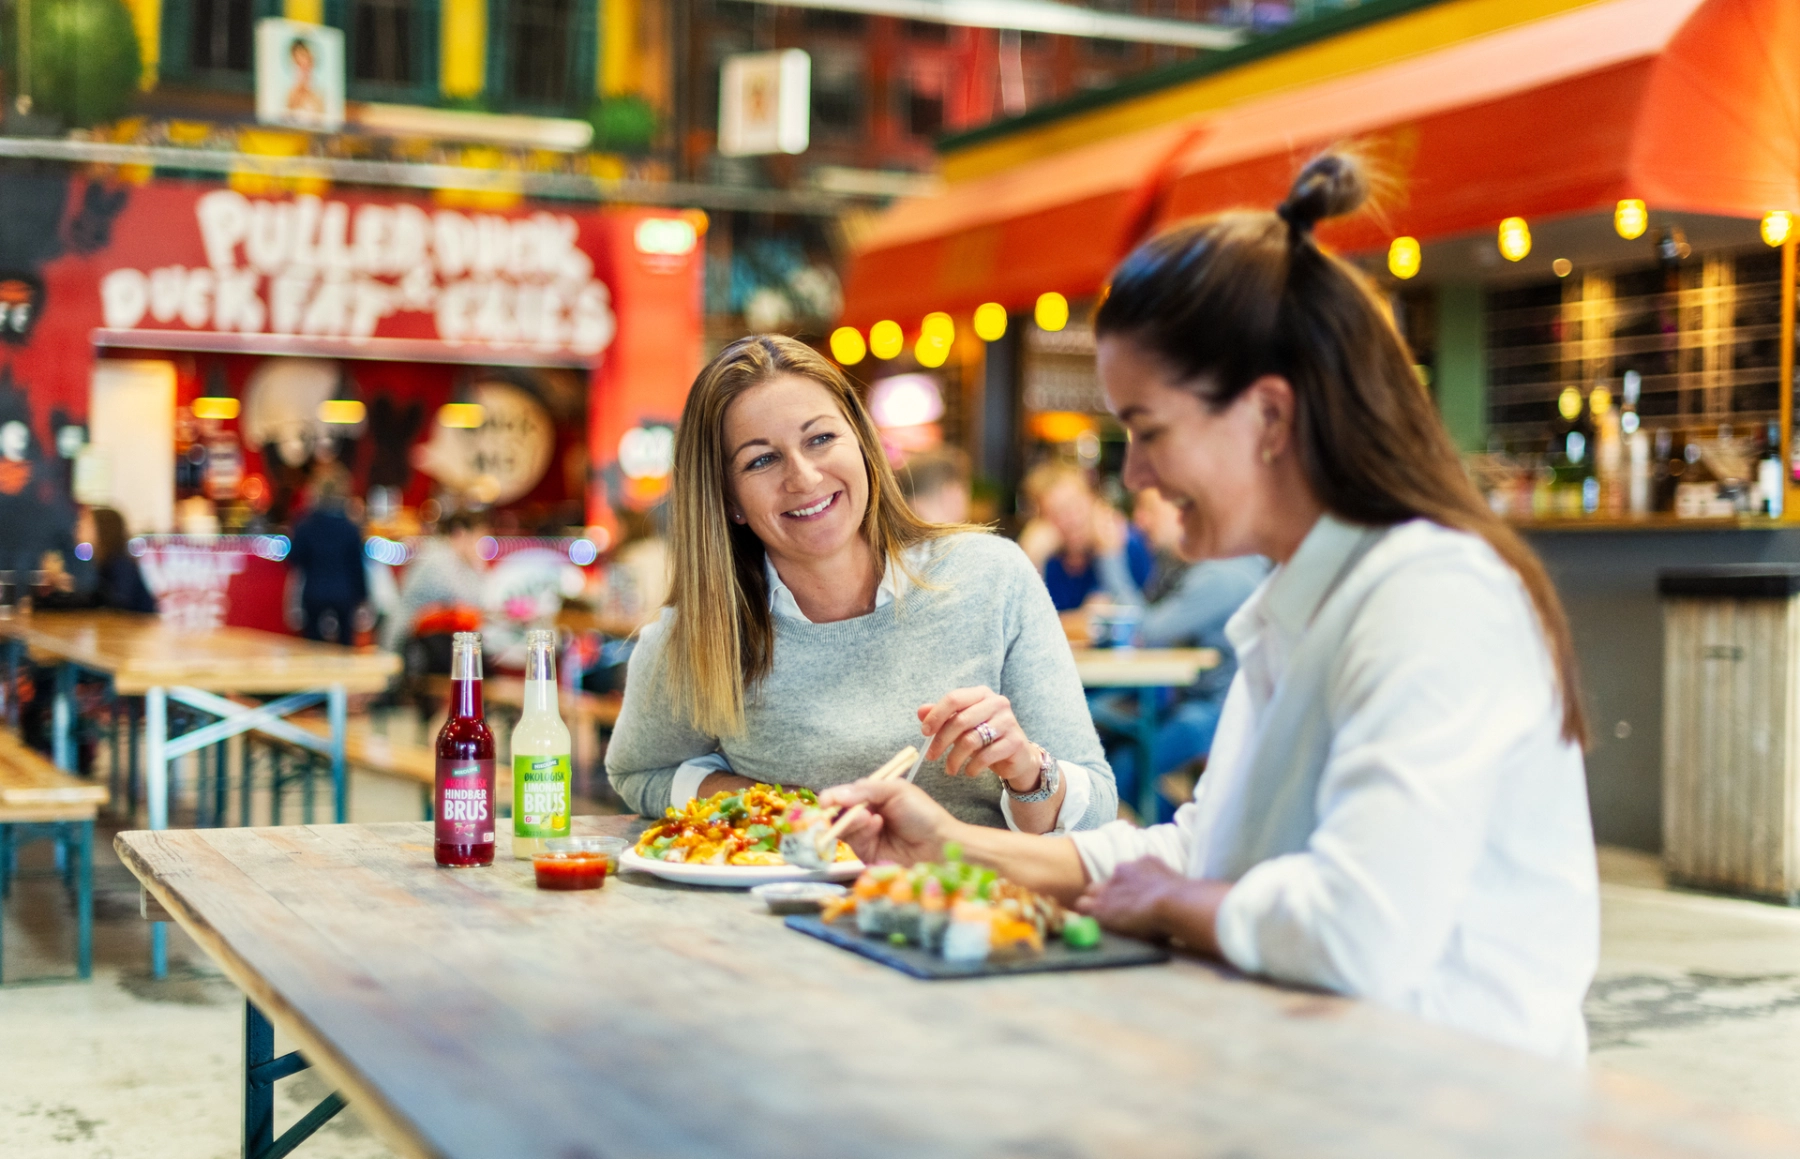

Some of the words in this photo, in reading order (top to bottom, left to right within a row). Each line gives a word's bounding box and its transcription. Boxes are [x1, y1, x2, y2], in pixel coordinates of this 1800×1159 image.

[196, 189, 432, 275] PULLED
[433, 210, 591, 281] DUCK
[101, 265, 266, 338] DUCK
[524, 772, 565, 781] ØKOLOGISK
[445, 789, 487, 799] HINDBÆR
[524, 782, 565, 792] LIMONADE
[444, 800, 488, 820] BRUS
[524, 793, 566, 813] BRUS
